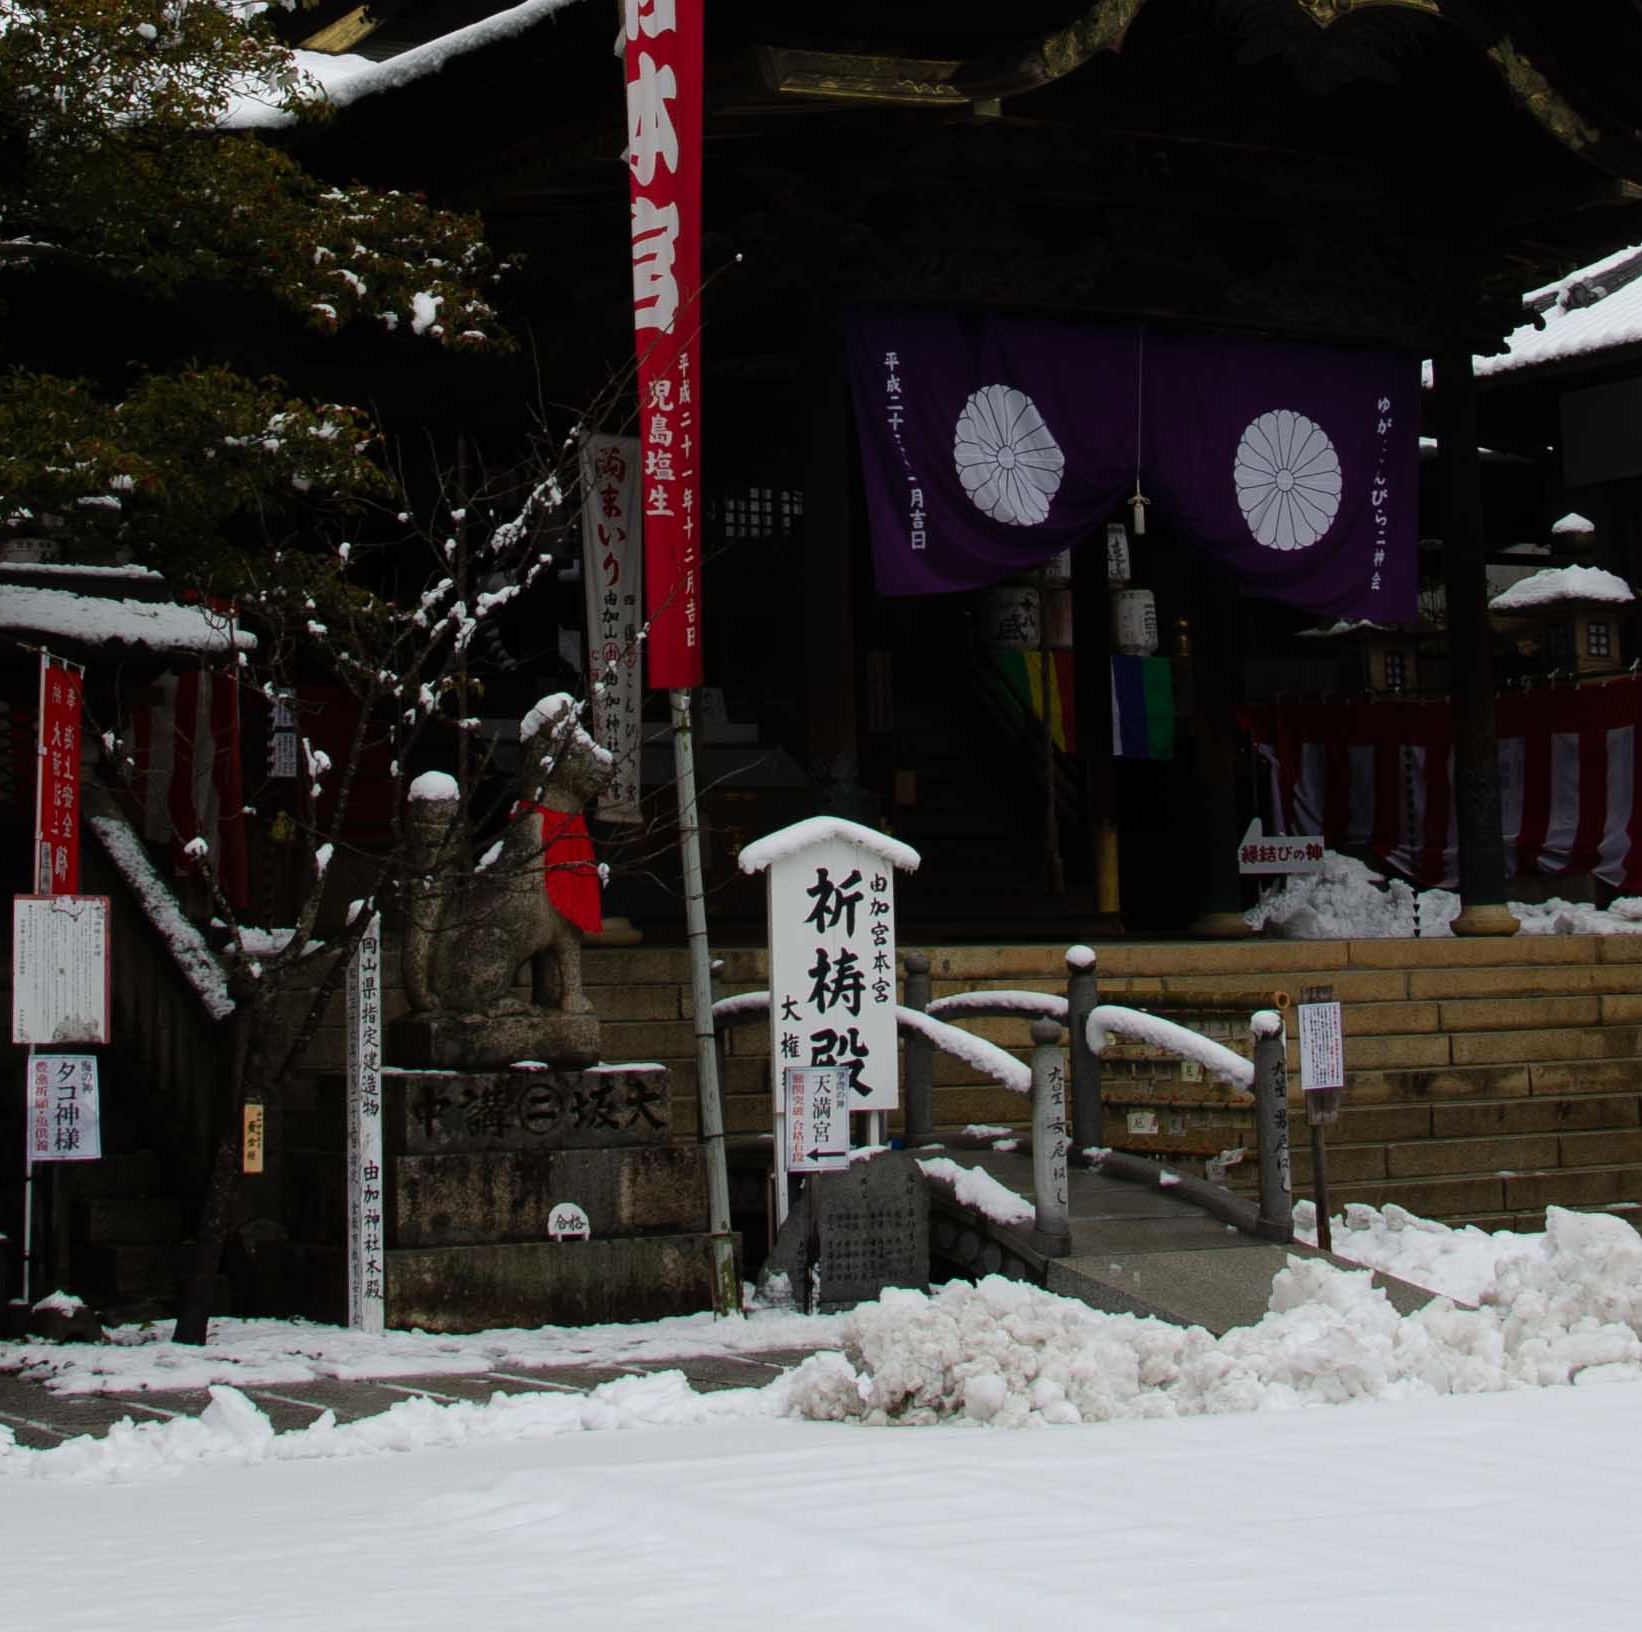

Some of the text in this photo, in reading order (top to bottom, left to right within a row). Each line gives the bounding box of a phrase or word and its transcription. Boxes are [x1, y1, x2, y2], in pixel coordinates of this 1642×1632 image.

[645, 380, 676, 518] 児島塩生
[1241, 843, 1323, 863] 縁結びの神
[869, 873, 891, 1004] 由加宮本宮
[54, 1061, 80, 1151] タコ神様
[812, 1073, 831, 1143] 天満宮
[364, 1160, 385, 1301] 由加神社本殿
[555, 1213, 587, 1230] 合格
